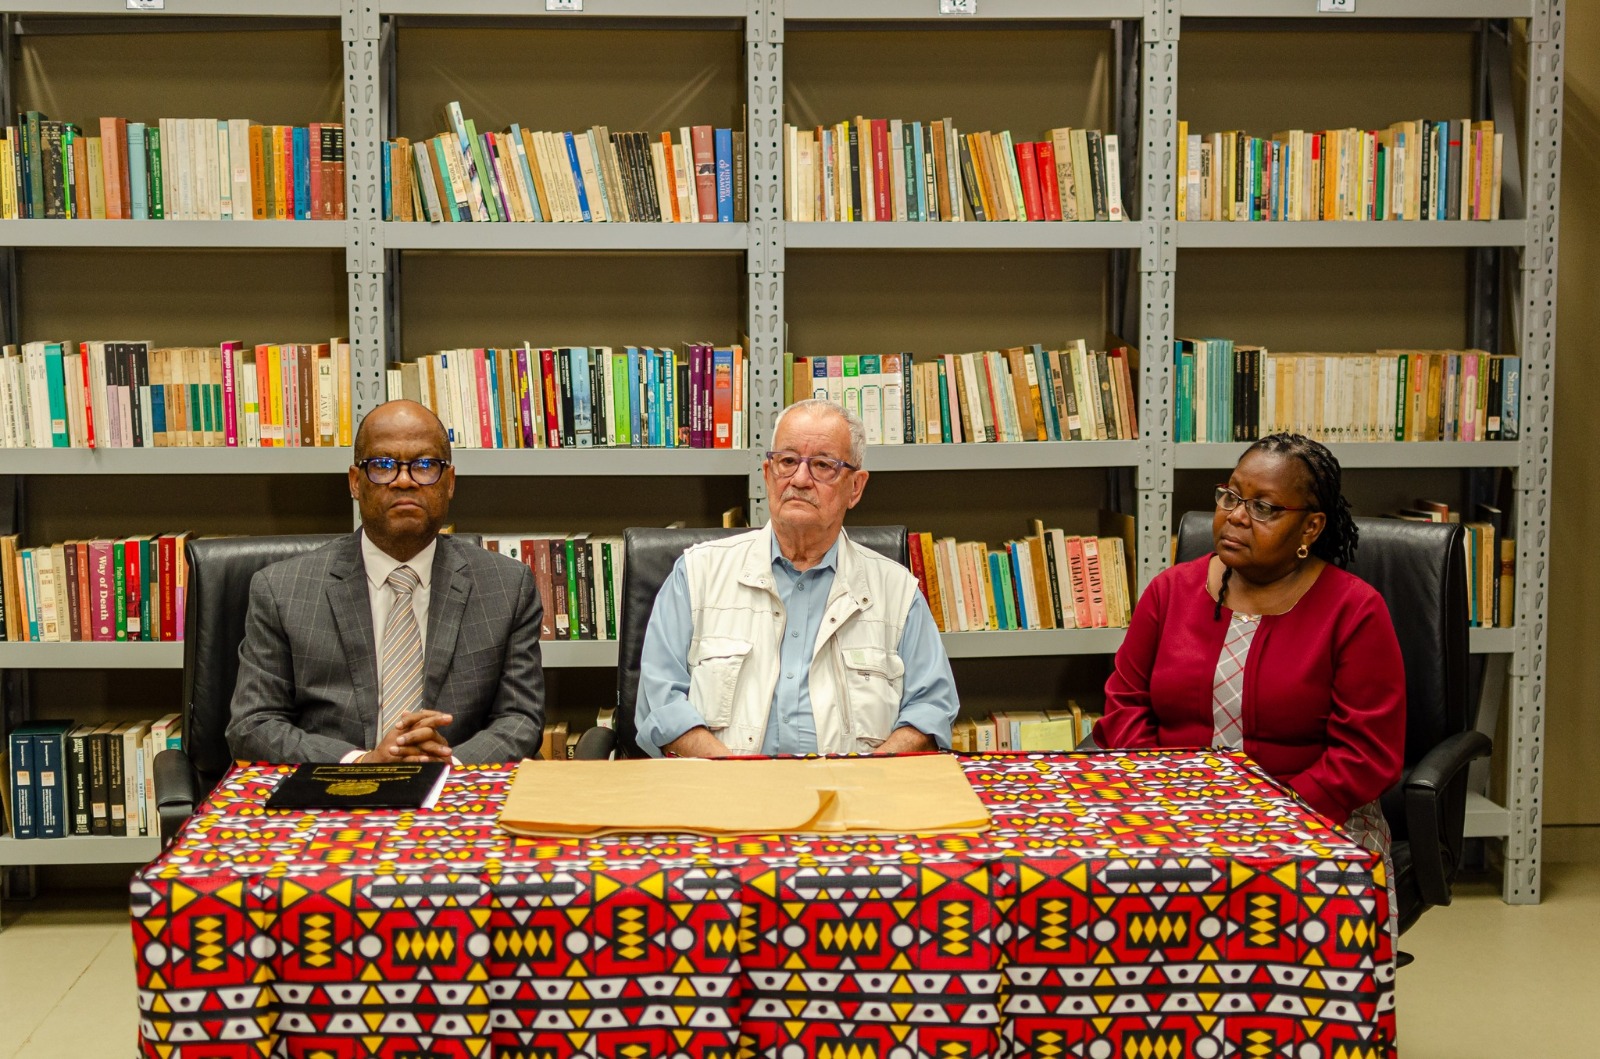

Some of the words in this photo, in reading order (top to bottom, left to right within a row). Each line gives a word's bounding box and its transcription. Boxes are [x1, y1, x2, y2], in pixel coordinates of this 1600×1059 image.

[448, 163, 457, 184] ANGOLA
[719, 159, 724, 168] OF
[1504, 371, 1518, 405] Stanley
[97, 555, 107, 575] Way
[1070, 554, 1084, 592] CAPITAL
[1087, 554, 1101, 593] CAPITAL
[99, 577, 107, 588] of
[99, 590, 108, 620] Death
